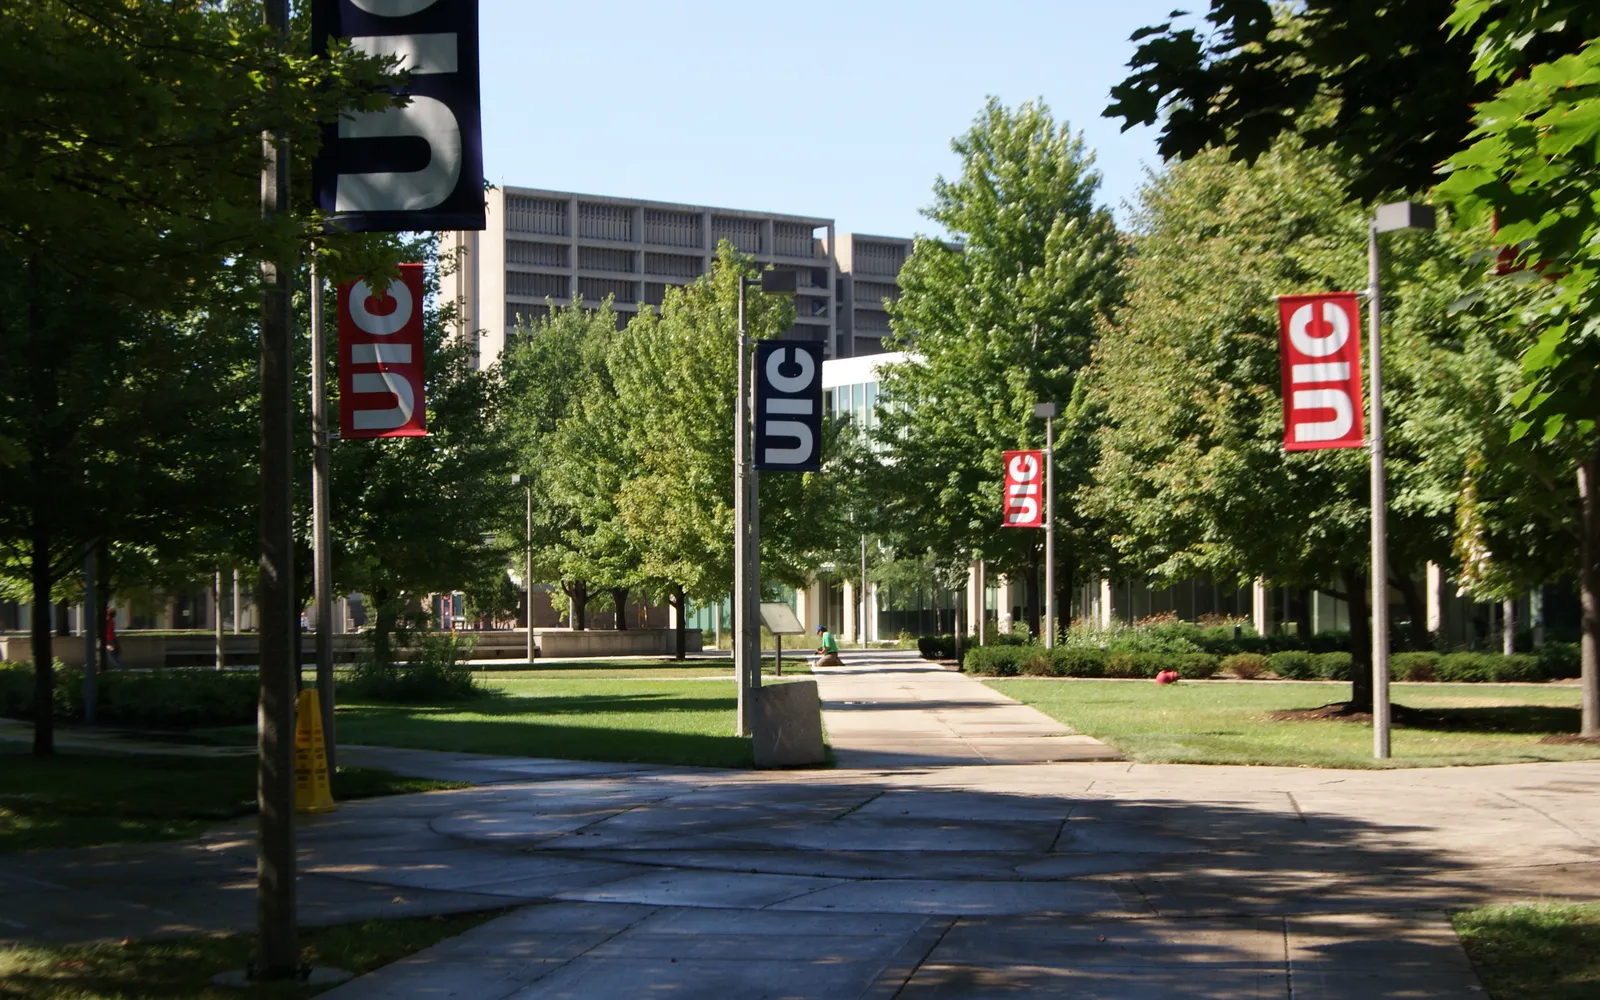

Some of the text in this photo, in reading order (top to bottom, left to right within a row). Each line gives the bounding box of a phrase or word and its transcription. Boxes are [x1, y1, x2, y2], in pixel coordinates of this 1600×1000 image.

[335, 0, 462, 212] UI
[349, 278, 415, 430] UIC
[765, 347, 815, 465] UIC
[1289, 302, 1354, 442] UIC
[1009, 454, 1038, 523] UIC
